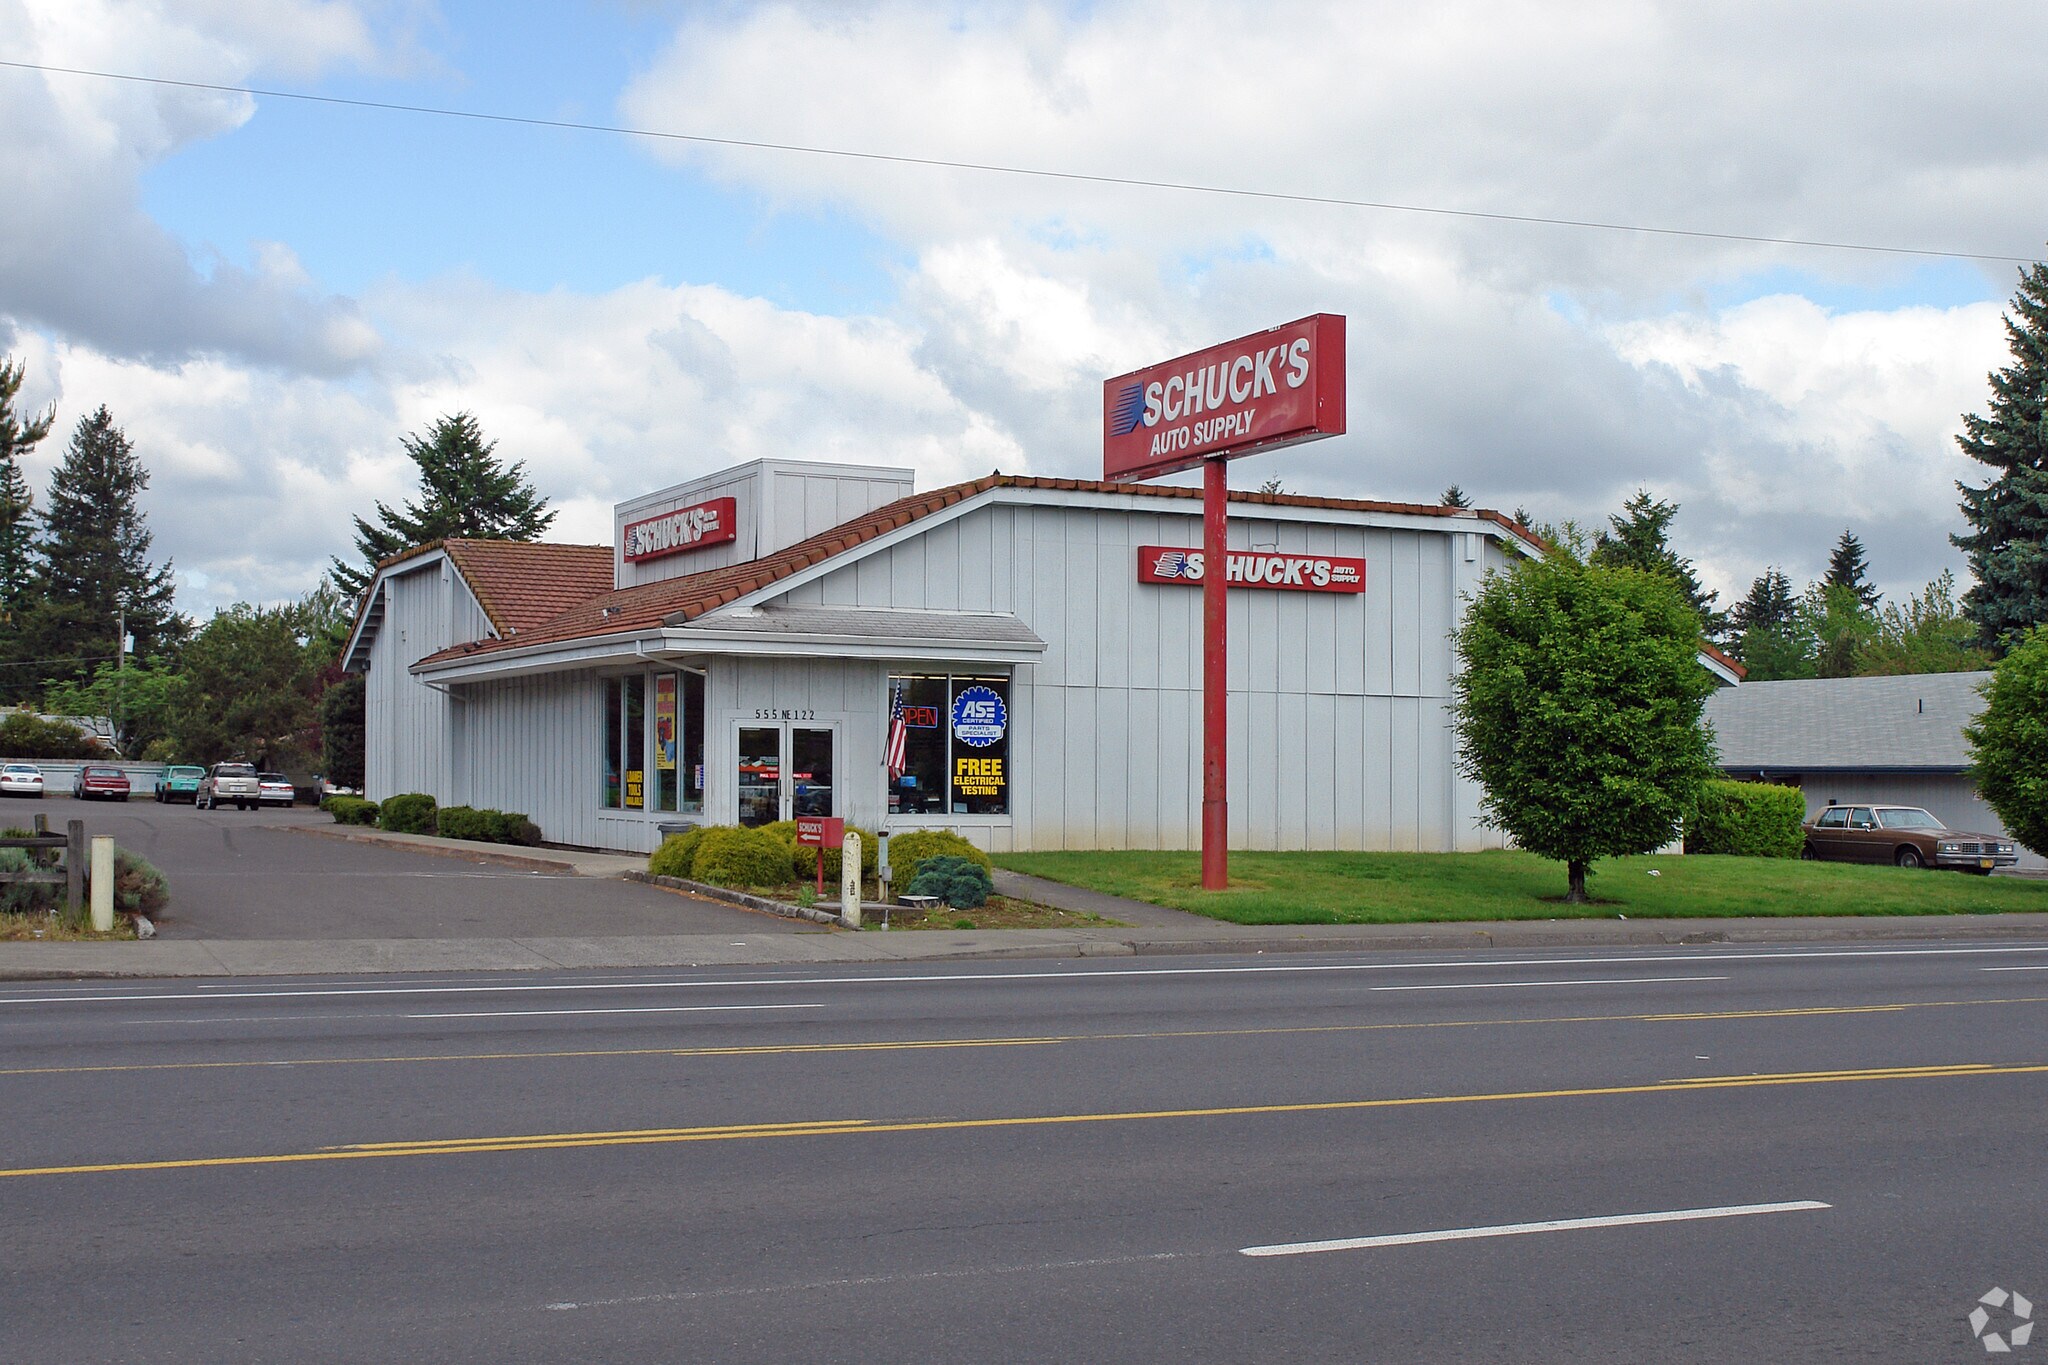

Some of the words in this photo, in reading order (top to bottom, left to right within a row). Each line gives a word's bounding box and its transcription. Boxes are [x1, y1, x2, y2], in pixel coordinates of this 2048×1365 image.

[1144, 338, 1309, 427] SCHUCK'S
[1150, 426, 1190, 456] AUTO
[1193, 408, 1255, 446] SUPPLY
[635, 508, 704, 555] SCHUCK'S
[1186, 553, 1331, 587] SHUCK'S
[755, 709, 777, 719] 555
[781, 709, 791, 720] NE
[794, 710, 815, 720] 122
[962, 701, 996, 718] ASE
[957, 758, 1003, 776] FREE
[953, 776, 1006, 786] ELECTRICAL
[961, 786, 998, 796] TESTING
